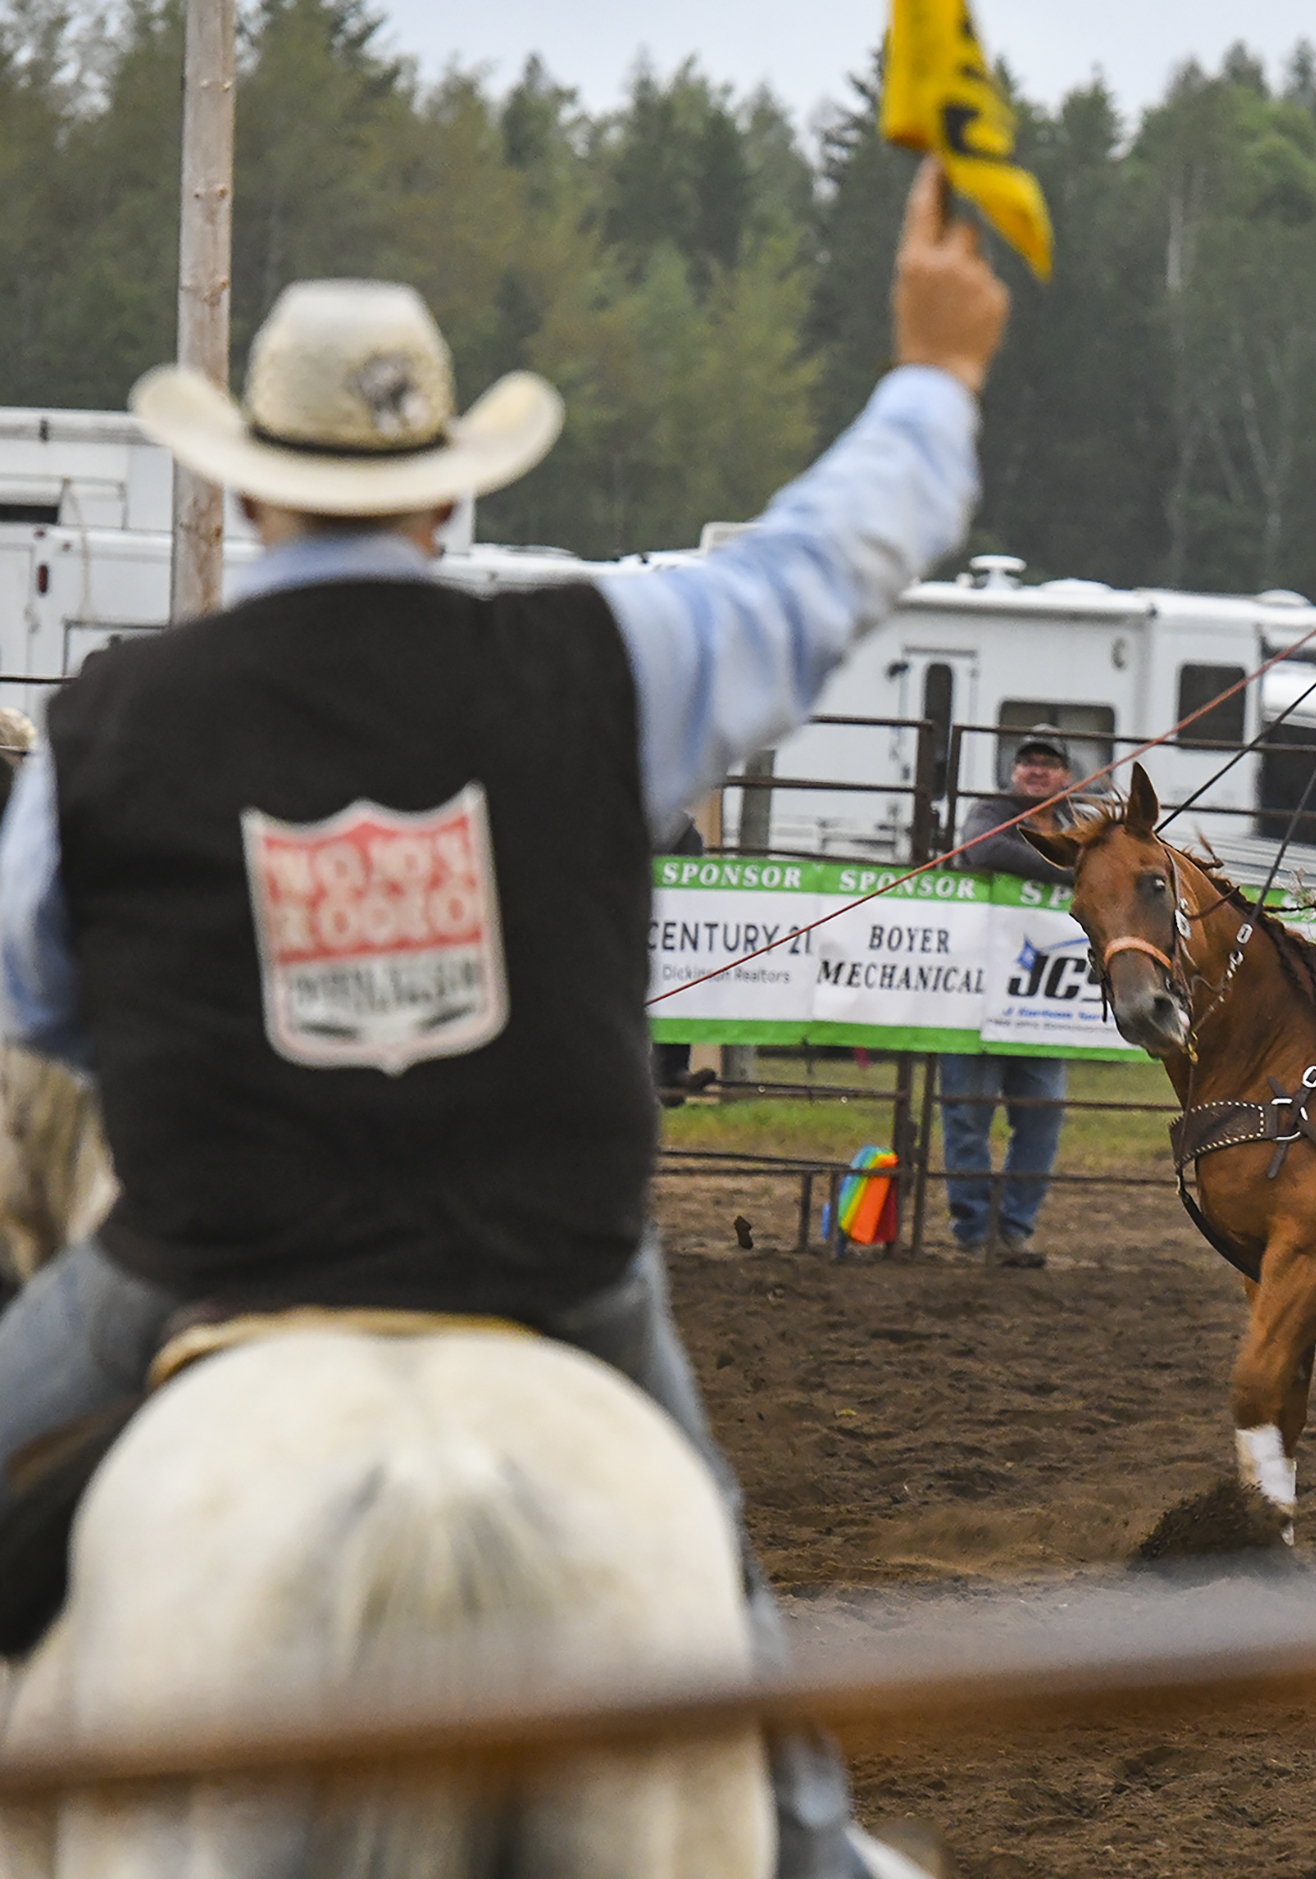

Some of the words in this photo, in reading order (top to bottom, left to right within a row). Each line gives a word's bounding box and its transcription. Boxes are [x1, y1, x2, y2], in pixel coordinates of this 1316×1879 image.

[661, 862, 802, 889] SPONSOR
[838, 869, 976, 899] SPONSOR
[649, 922, 780, 954] CENTURY
[788, 926, 813, 955] 21
[868, 924, 951, 954] BOYER
[817, 960, 987, 995] MECHANICAL
